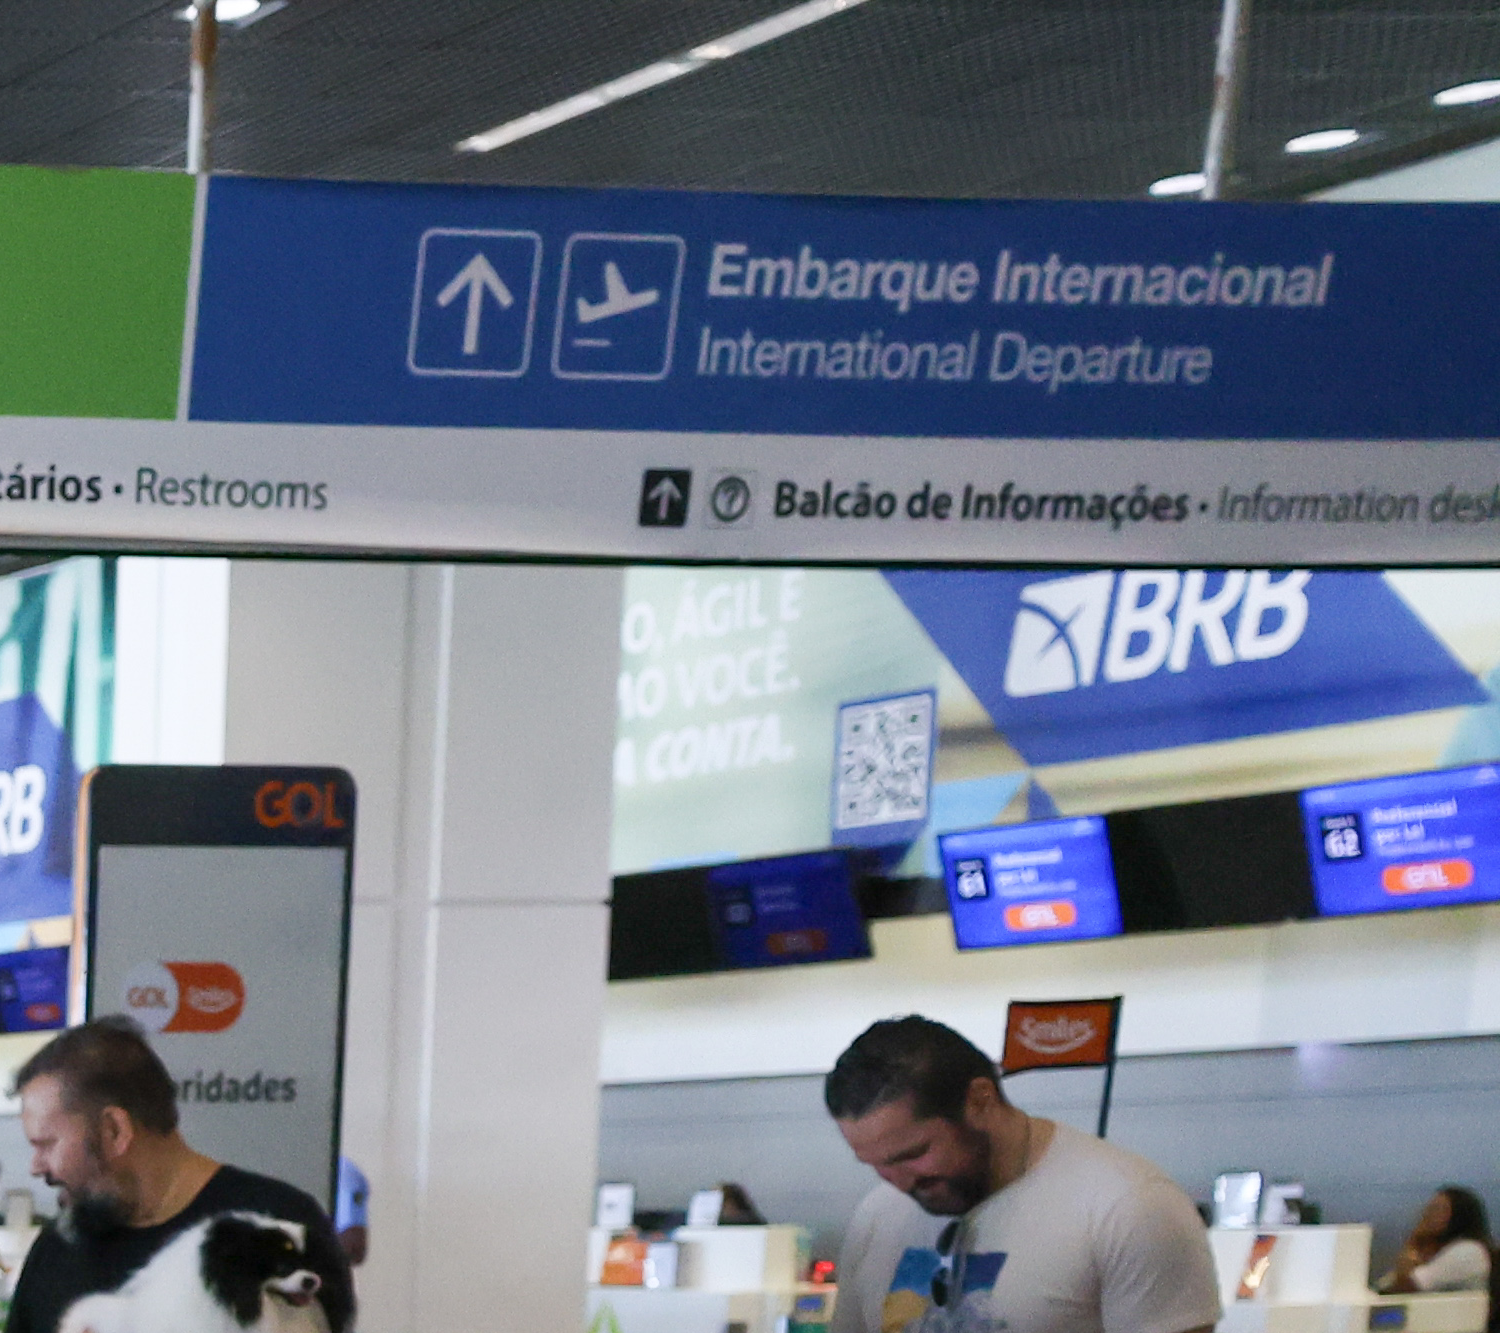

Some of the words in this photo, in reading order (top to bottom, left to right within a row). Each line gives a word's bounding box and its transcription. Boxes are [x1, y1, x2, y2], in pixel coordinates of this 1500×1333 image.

[706, 243, 980, 312] Embarque
[991, 249, 1334, 308] Internacional
[697, 326, 979, 381] International
[989, 331, 1213, 391] Departure
[136, 468, 328, 511] Restrooms
[774, 480, 897, 520] Balcão
[905, 482, 953, 520] de
[961, 482, 1189, 531] Informações
[1218, 483, 1420, 524] Information
[671, 577, 765, 645] ÁGIL
[1102, 569, 1313, 683] BRB
[645, 712, 798, 783] CONTA.
[254, 780, 346, 829] GOL
